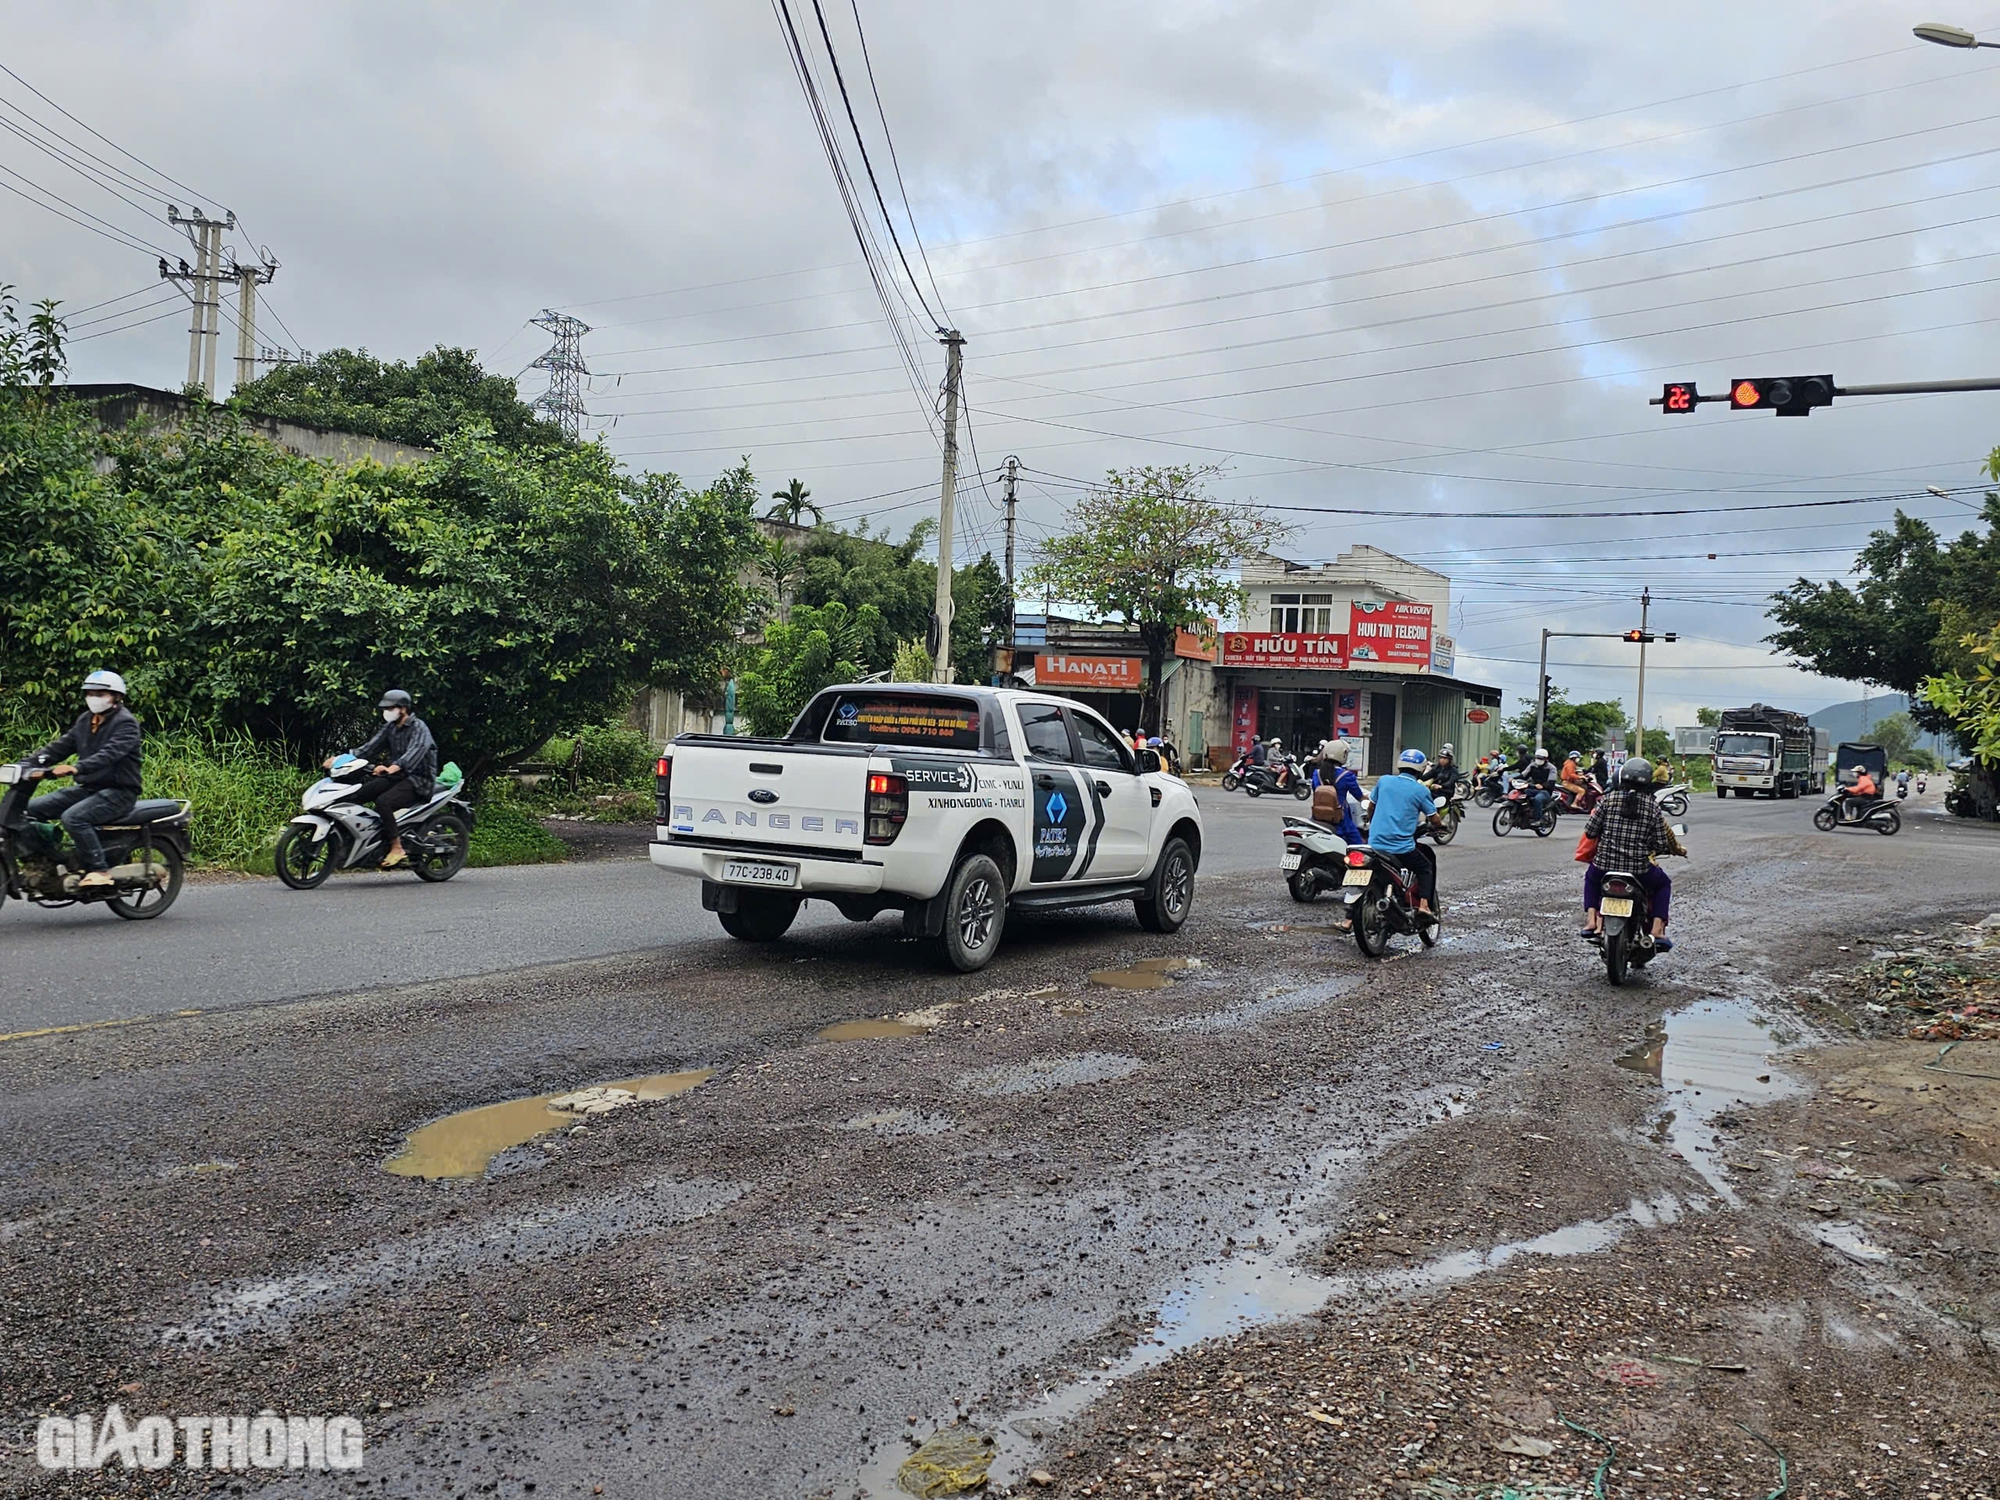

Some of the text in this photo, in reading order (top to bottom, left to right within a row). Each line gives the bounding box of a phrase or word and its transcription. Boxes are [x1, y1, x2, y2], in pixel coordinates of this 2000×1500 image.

[1395, 604, 1432, 615] HIKVISION
[1357, 622, 1427, 640] HUU TIN TELECOM
[1253, 634, 1338, 655] HỮU TÍN
[869, 724, 899, 733] Hotline:
[922, 727, 937, 736] 710
[906, 770, 956, 783] SERVICE
[928, 798, 993, 808] XINHONGDONG
[673, 805, 859, 835] RANGER
[729, 865, 789, 882] 77C-238.40
